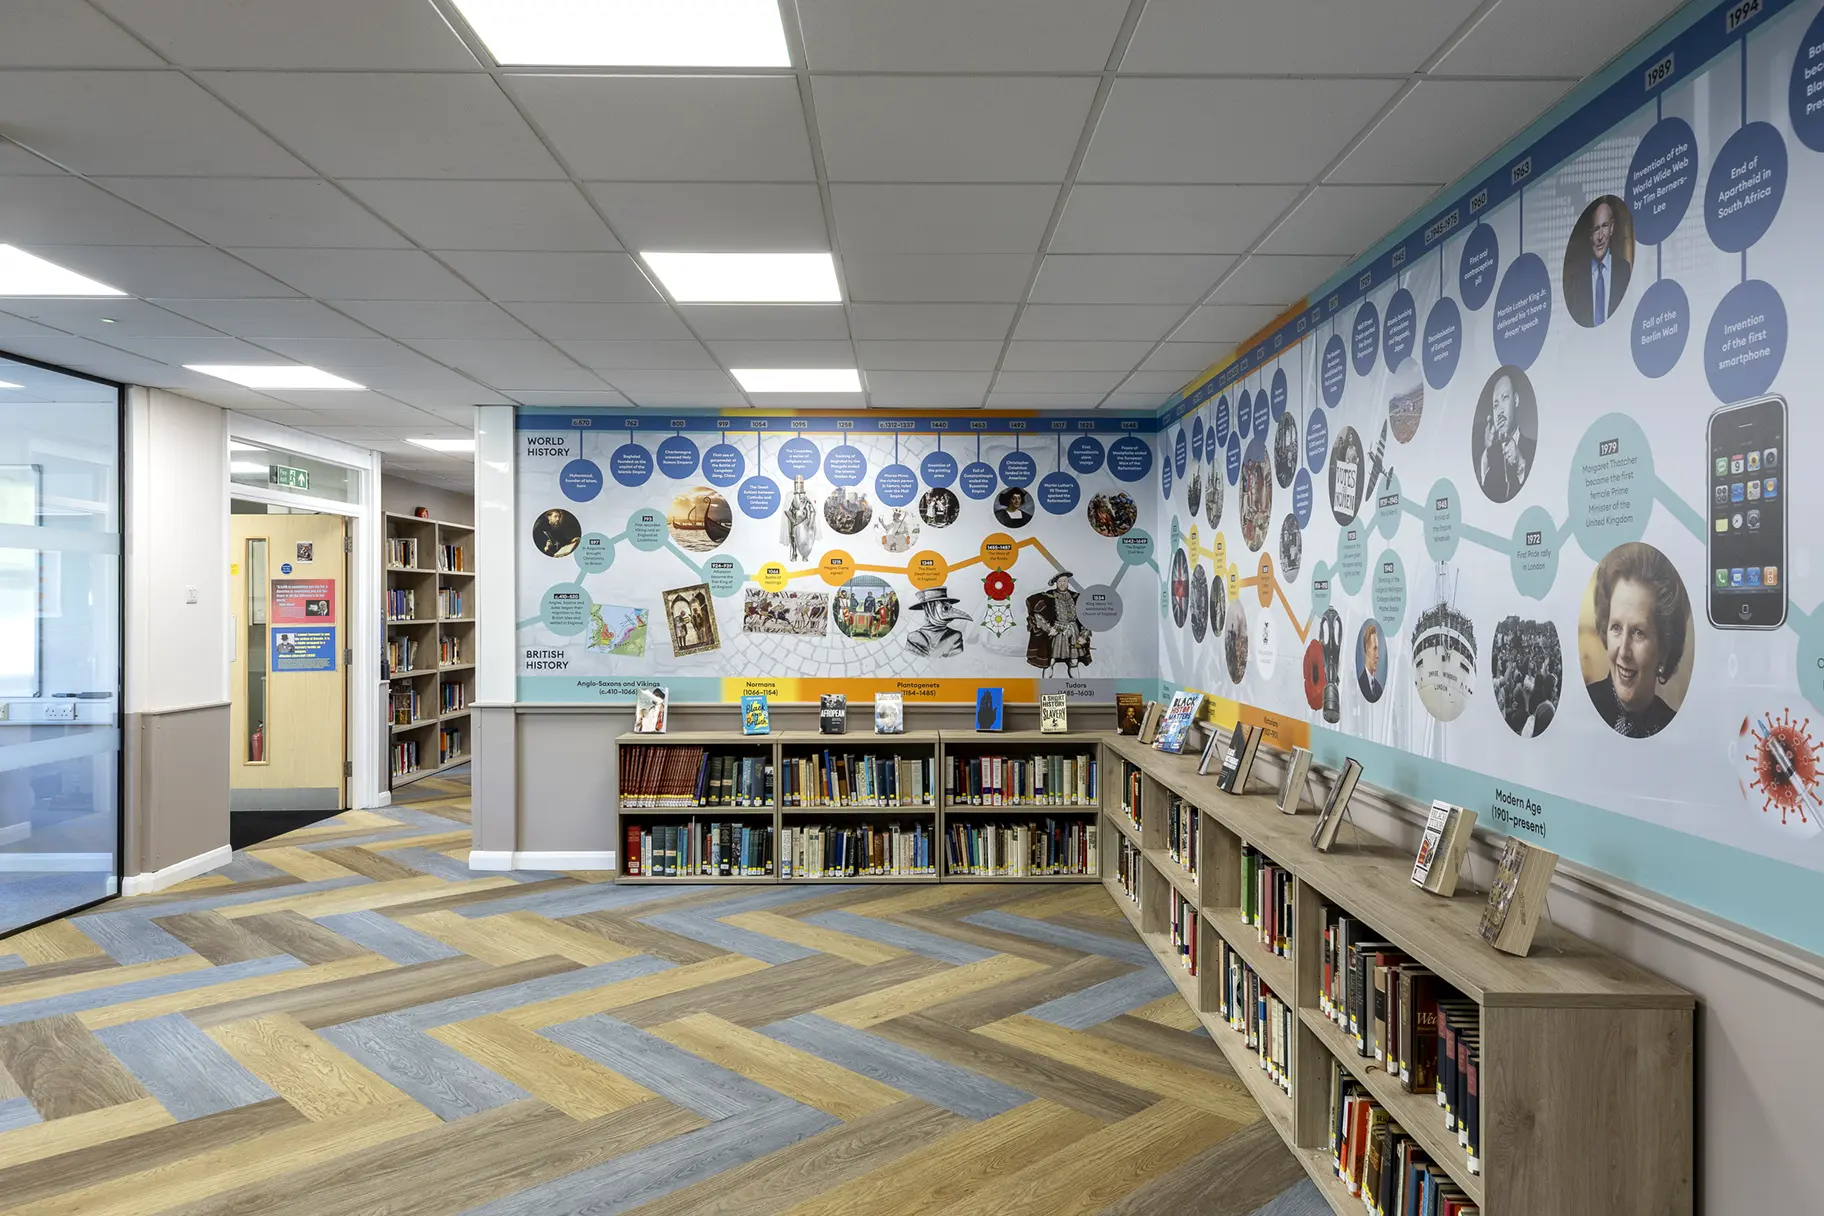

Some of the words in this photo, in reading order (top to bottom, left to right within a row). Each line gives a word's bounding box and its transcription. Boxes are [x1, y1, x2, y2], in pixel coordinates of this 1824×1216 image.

[1729, 0, 1759, 28] 1994
[1647, 59, 1672, 87] 1989
[1633, 156, 1666, 181] Invention
[1666, 150, 1675, 161] of
[1674, 143, 1688, 157] the
[1731, 166, 1747, 179] End
[1748, 156, 1758, 170] of
[1512, 162, 1530, 182] 1963
[1633, 180, 1652, 196] World
[1653, 170, 1672, 186] Wide
[1672, 158, 1689, 173] Web
[1634, 198, 1642, 210] by
[1642, 193, 1656, 206] Tim
[1656, 177, 1688, 199] Berners-
[1718, 174, 1761, 203] Apartheid
[1762, 168, 1772, 180] in
[1471, 194, 1486, 211] 1960
[1653, 202, 1666, 215] Lee
[1718, 201, 1742, 219] South
[1744, 186, 1772, 204] Africa
[1469, 255, 1479, 266] First
[1479, 248, 1488, 258] oral
[1464, 258, 1494, 280] contraceptive
[1474, 275, 1482, 286] pill
[1497, 305, 1512, 318] Martin
[1512, 297, 1528, 311] Luther
[1529, 292, 1540, 303] King
[1497, 315, 1518, 330] delivered
[1530, 304, 1542, 315] have
[1521, 318, 1538, 334] speech
[1642, 316, 1654, 330] Fall
[1655, 314, 1664, 325] of
[1664, 310, 1677, 322] the
[1724, 314, 1764, 336] Invention
[1641, 330, 1662, 346] Berlin
[1662, 324, 1678, 337] Wall
[1722, 340, 1732, 352] of
[1732, 336, 1746, 349] the
[1748, 328, 1768, 344] first
[1718, 346, 1770, 370] smartphone
[527, 437, 564, 446] WORLD
[1601, 442, 1617, 455] 1979
[527, 448, 570, 456] HISTORY
[1582, 462, 1609, 474] Margaret
[1610, 456, 1638, 468] Thatcher
[1735, 461, 1740, 472] 9
[1585, 477, 1609, 487] became
[1610, 474, 1620, 482] the
[1621, 471, 1634, 480] first
[1590, 490, 1610, 500] female
[1612, 487, 1629, 496] Prime
[1589, 503, 1612, 514] Minister
[1612, 502, 1619, 510] of
[1620, 501, 1630, 509] the
[1586, 517, 1604, 527] United
[1606, 514, 1633, 526] Kingdom
[1527, 534, 1540, 544] 1972
[1528, 550, 1539, 558] Pride
[526, 650, 564, 659] BRITISH
[526, 661, 569, 670] HISTORY
[746, 703, 766, 714] Black
[1173, 696, 1198, 707] BLACK
[820, 709, 845, 717] AFROPEAN
[1043, 708, 1066, 721] SLAVERY
[1496, 789, 1524, 809] Modern
[1526, 799, 1542, 816] Age
[1492, 805, 1546, 838] (1901–present)
